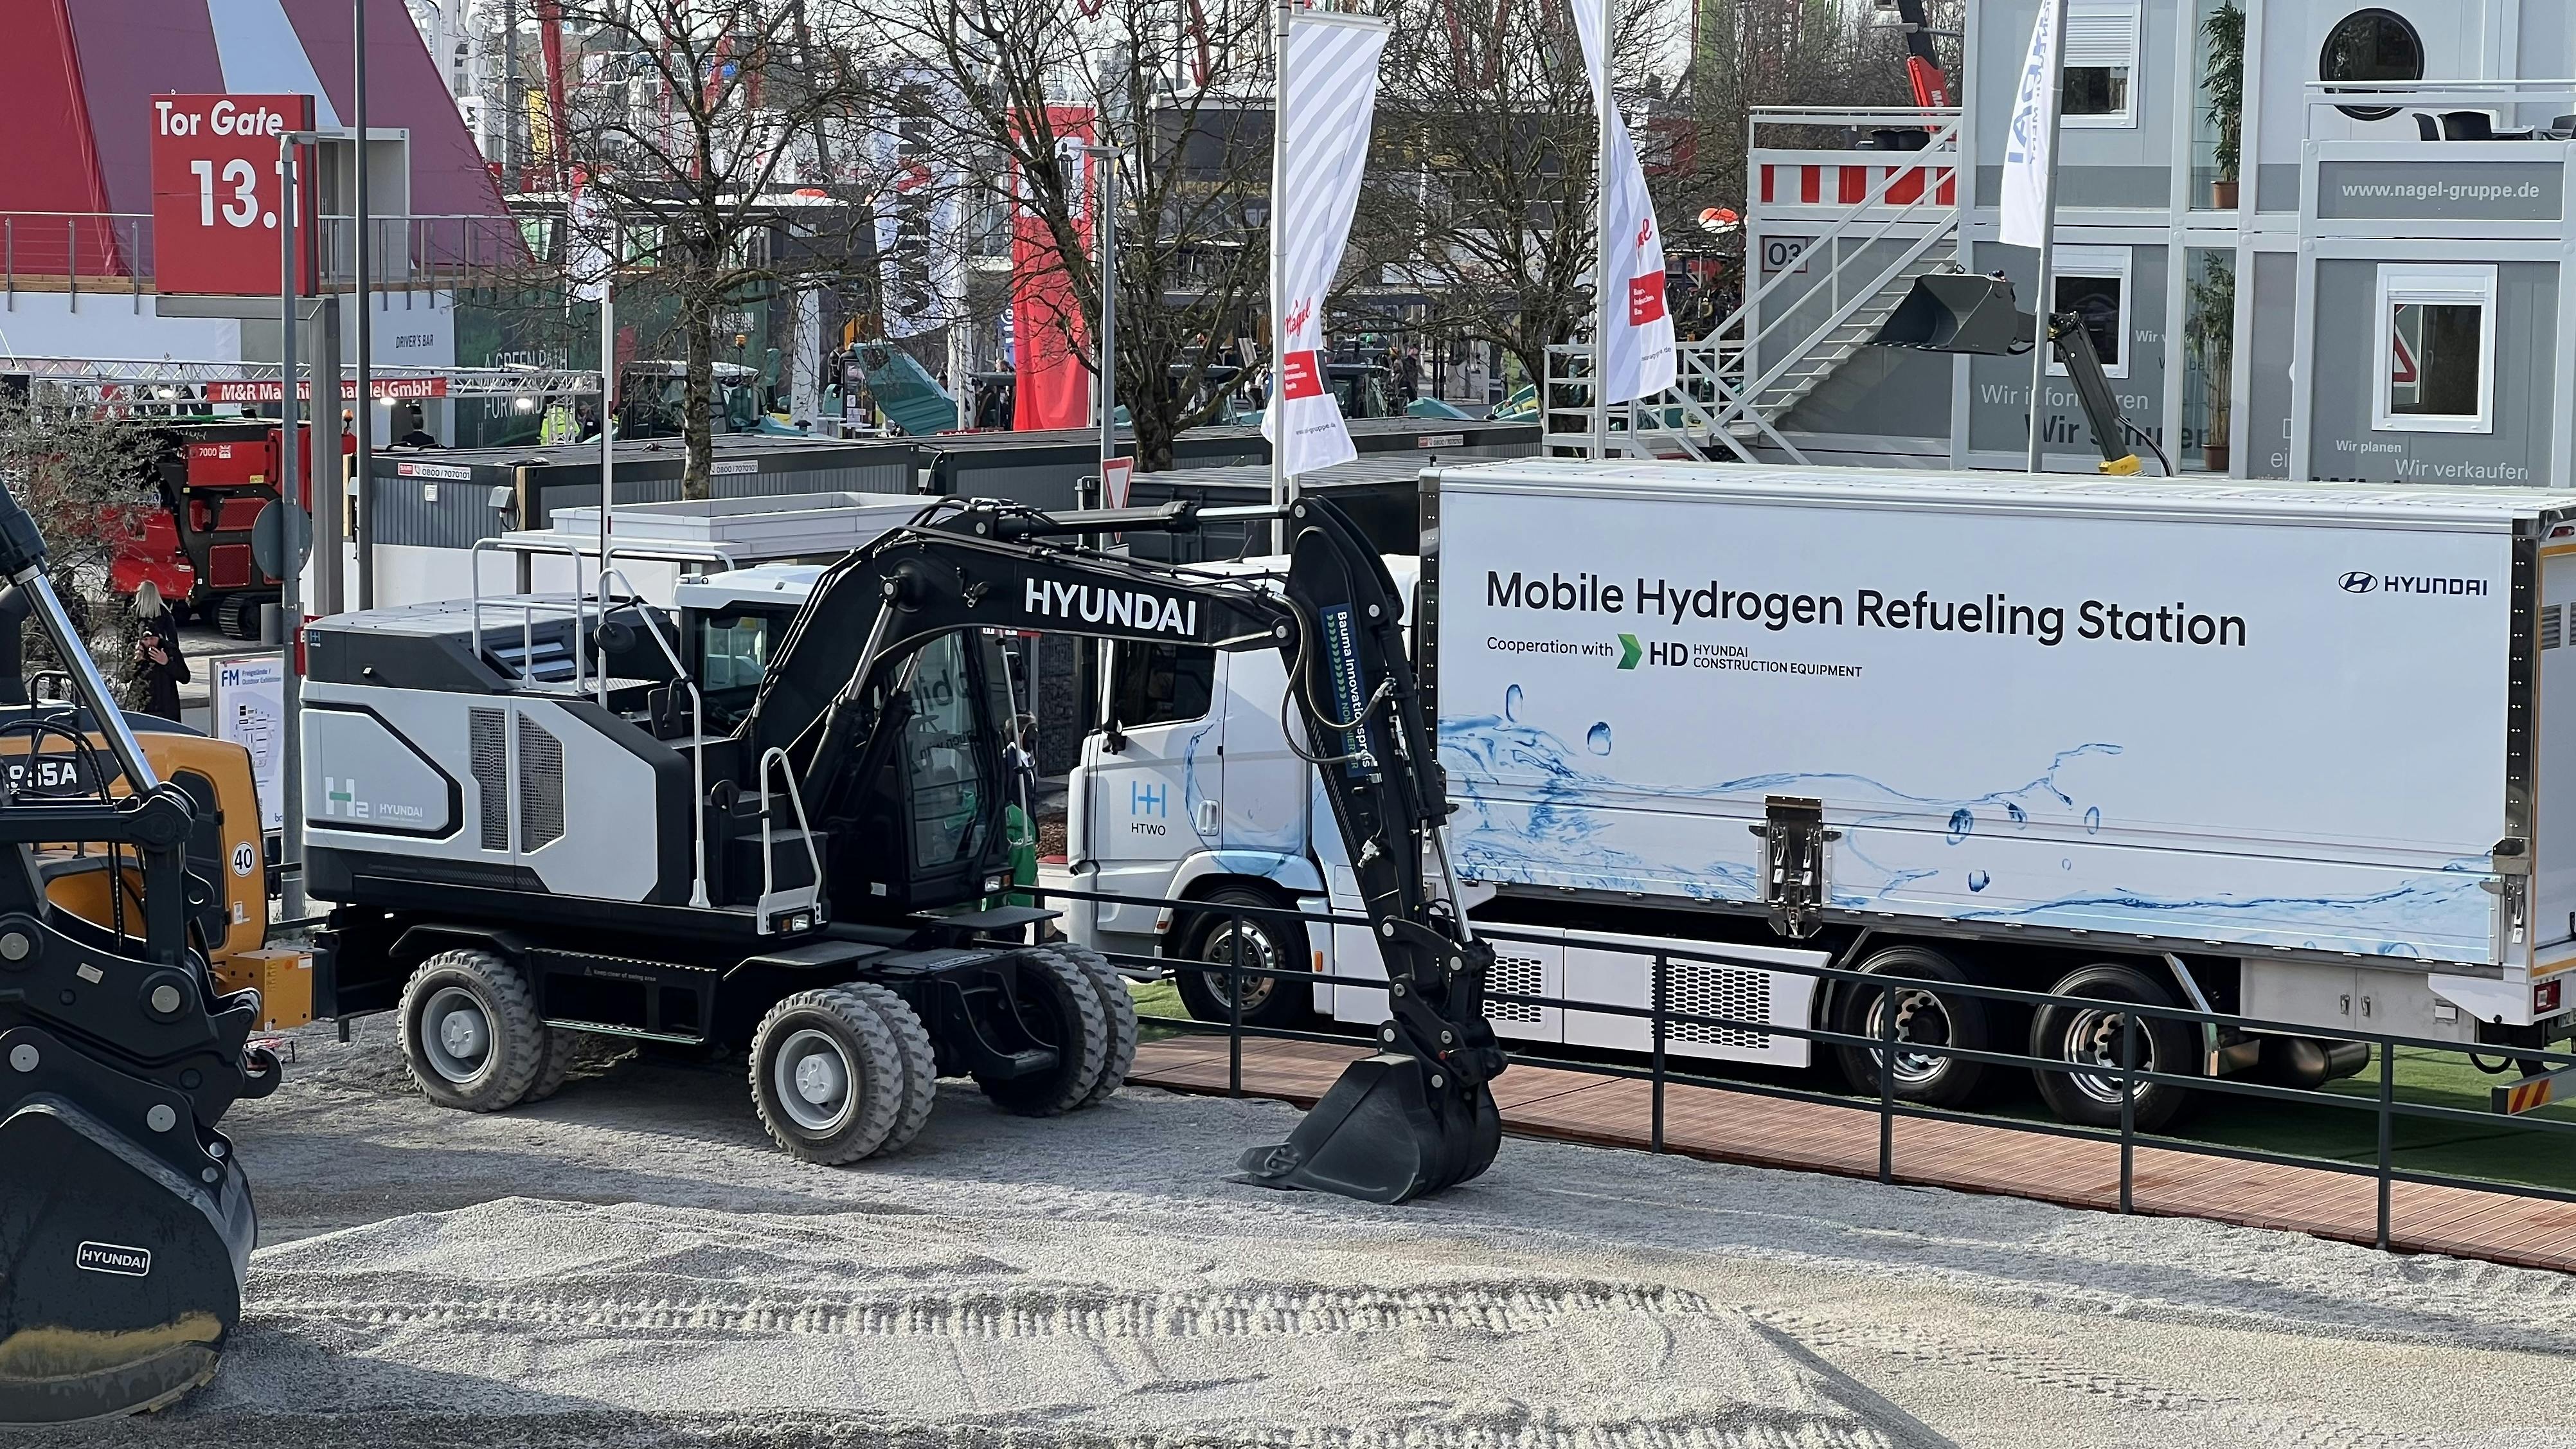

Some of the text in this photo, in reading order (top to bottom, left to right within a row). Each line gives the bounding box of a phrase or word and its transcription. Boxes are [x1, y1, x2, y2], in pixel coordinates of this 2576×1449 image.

[155, 100, 283, 137] Tor Gate
[2342, 181, 2539, 201] www.nagel-gruppe.de
[422, 334, 434, 346] BAR
[2135, 330, 2158, 342] Wir
[221, 383, 256, 401] M&R
[388, 379, 433, 398] GmbH
[1981, 384, 2149, 410] Wir iforren
[484, 395, 543, 420] FORWRD
[199, 447, 217, 457] 7000
[2336, 440, 2402, 454] Wir planen
[2395, 458, 2528, 480] Wir verkaufen
[2383, 575, 2488, 597] HYUNDAI
[1025, 577, 1197, 636] HYUNDAI
[1487, 570, 2247, 647] Mobile Hydrogen Refueling Station
[1337, 611, 1352, 657] Bauma
[1487, 636, 1748, 667] Cooperation with HD HYUNDAI
[221, 669, 239, 687] FM
[1694, 657, 1863, 678] CONSTRUCTION EQUIPMENT
[380, 804, 423, 818] HYUNDAI
[1131, 822, 1166, 836] HTWO
[234, 848, 253, 870] 40
[82, 1249, 146, 1270] HYUNDAI
